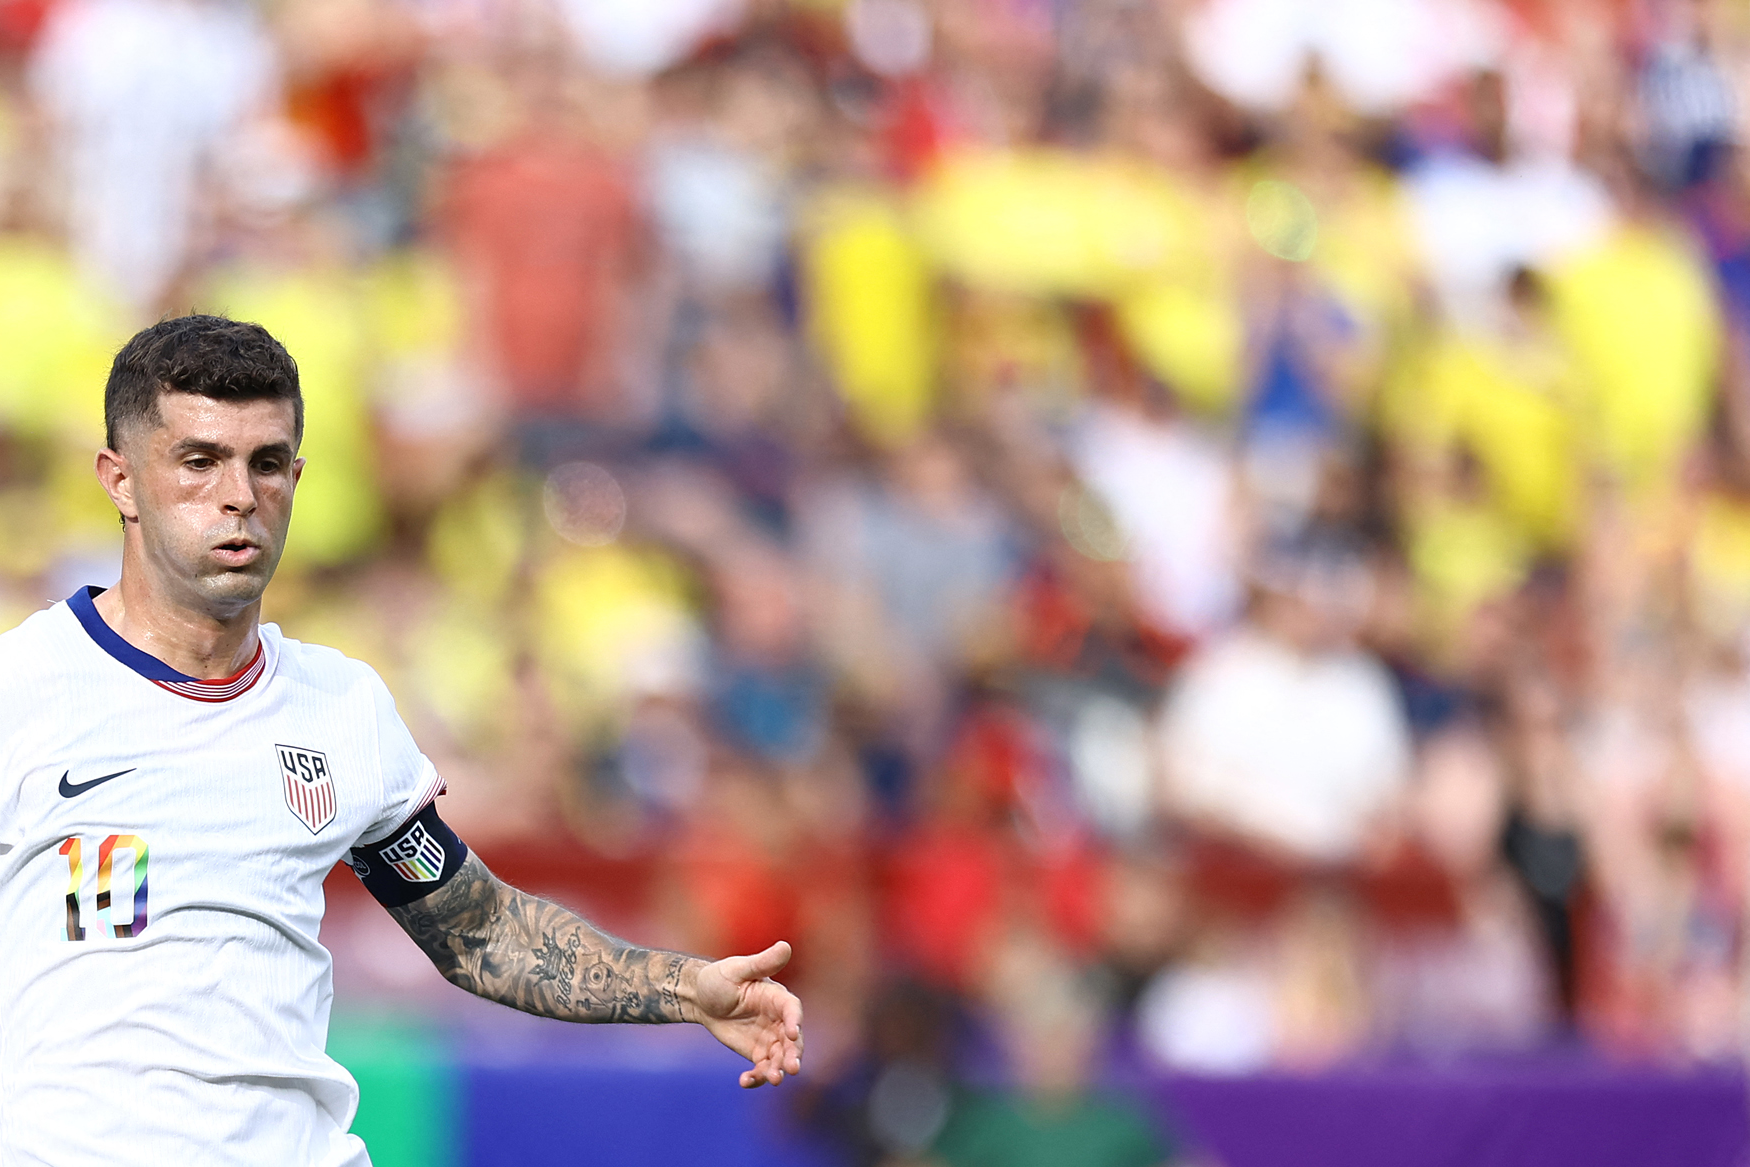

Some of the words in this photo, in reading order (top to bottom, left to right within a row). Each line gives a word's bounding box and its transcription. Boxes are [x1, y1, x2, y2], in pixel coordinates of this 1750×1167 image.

[280, 750, 326, 783] USA
[383, 826, 425, 863] USA
[58, 834, 149, 941] 10
